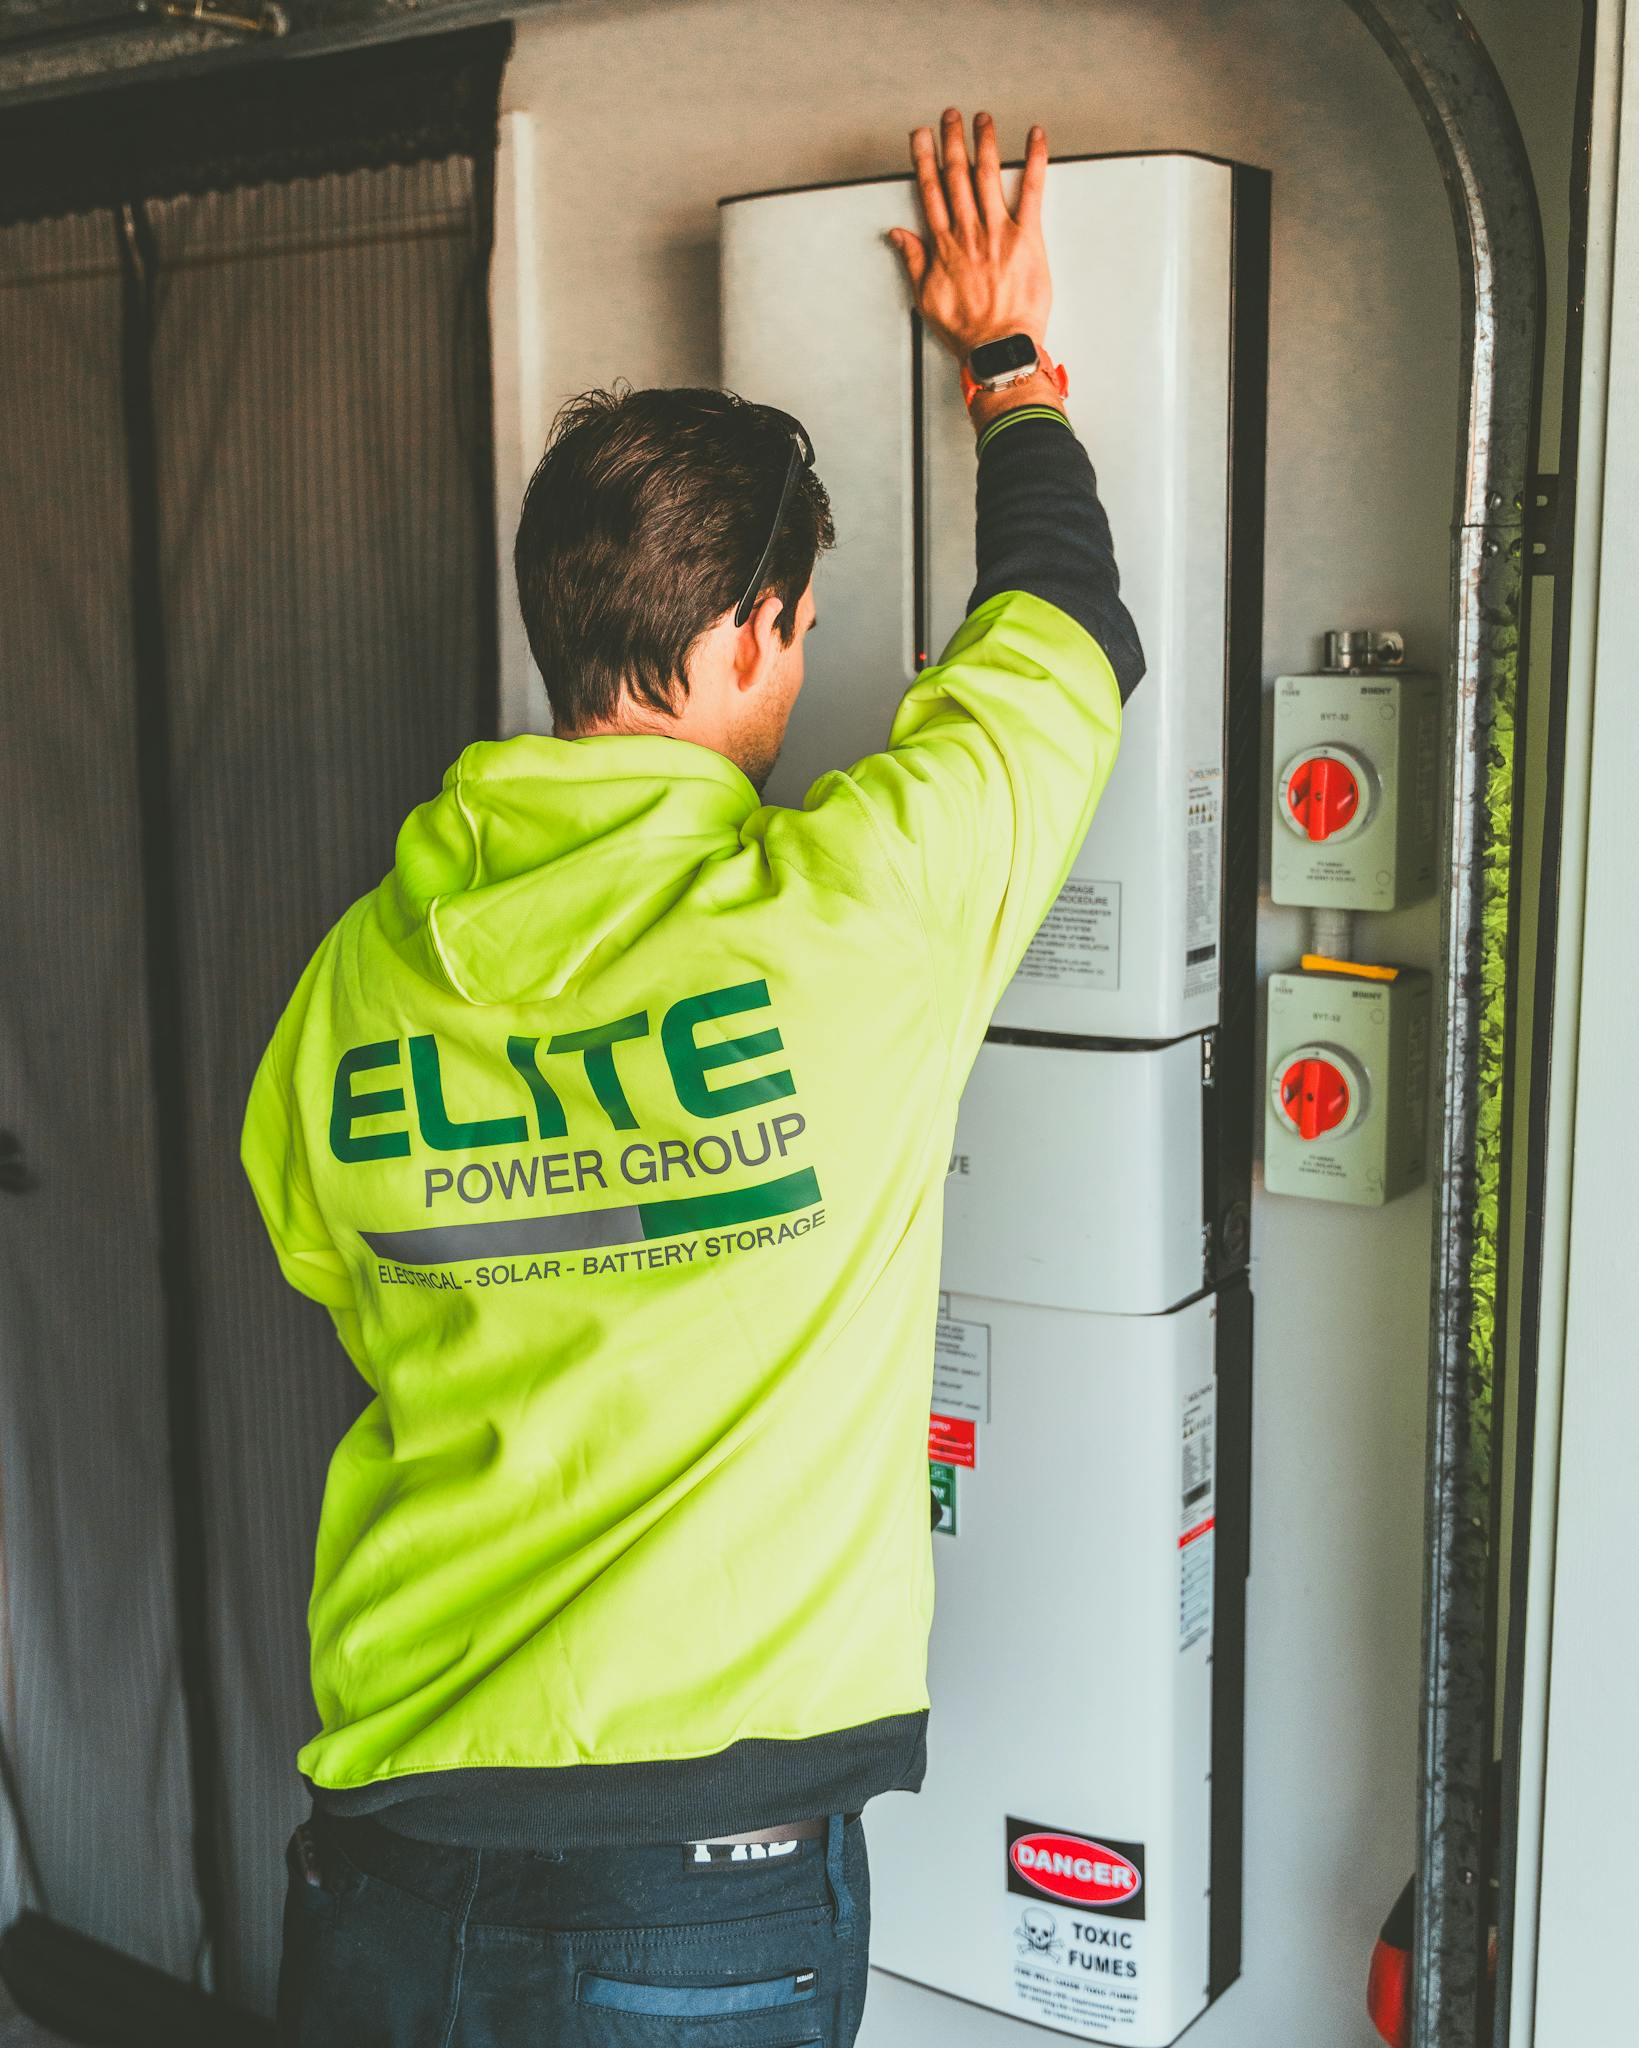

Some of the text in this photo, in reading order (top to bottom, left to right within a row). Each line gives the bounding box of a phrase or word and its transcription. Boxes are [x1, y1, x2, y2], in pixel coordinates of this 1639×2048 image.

[1056, 895, 1108, 906] ROCEDURE
[329, 978, 797, 1164] ELITE
[425, 1112, 807, 1208] POWER GROUP
[378, 1265, 462, 1291] ELECTRICAL
[476, 1259, 561, 1288] SOLAR
[582, 1240, 698, 1276] BATTERY
[704, 1208, 826, 1257] STORAGE
[1017, 1843, 1132, 1888] DANGER
[1072, 1922, 1132, 1950] TOXIC
[1069, 1950, 1137, 1978] FUMES
